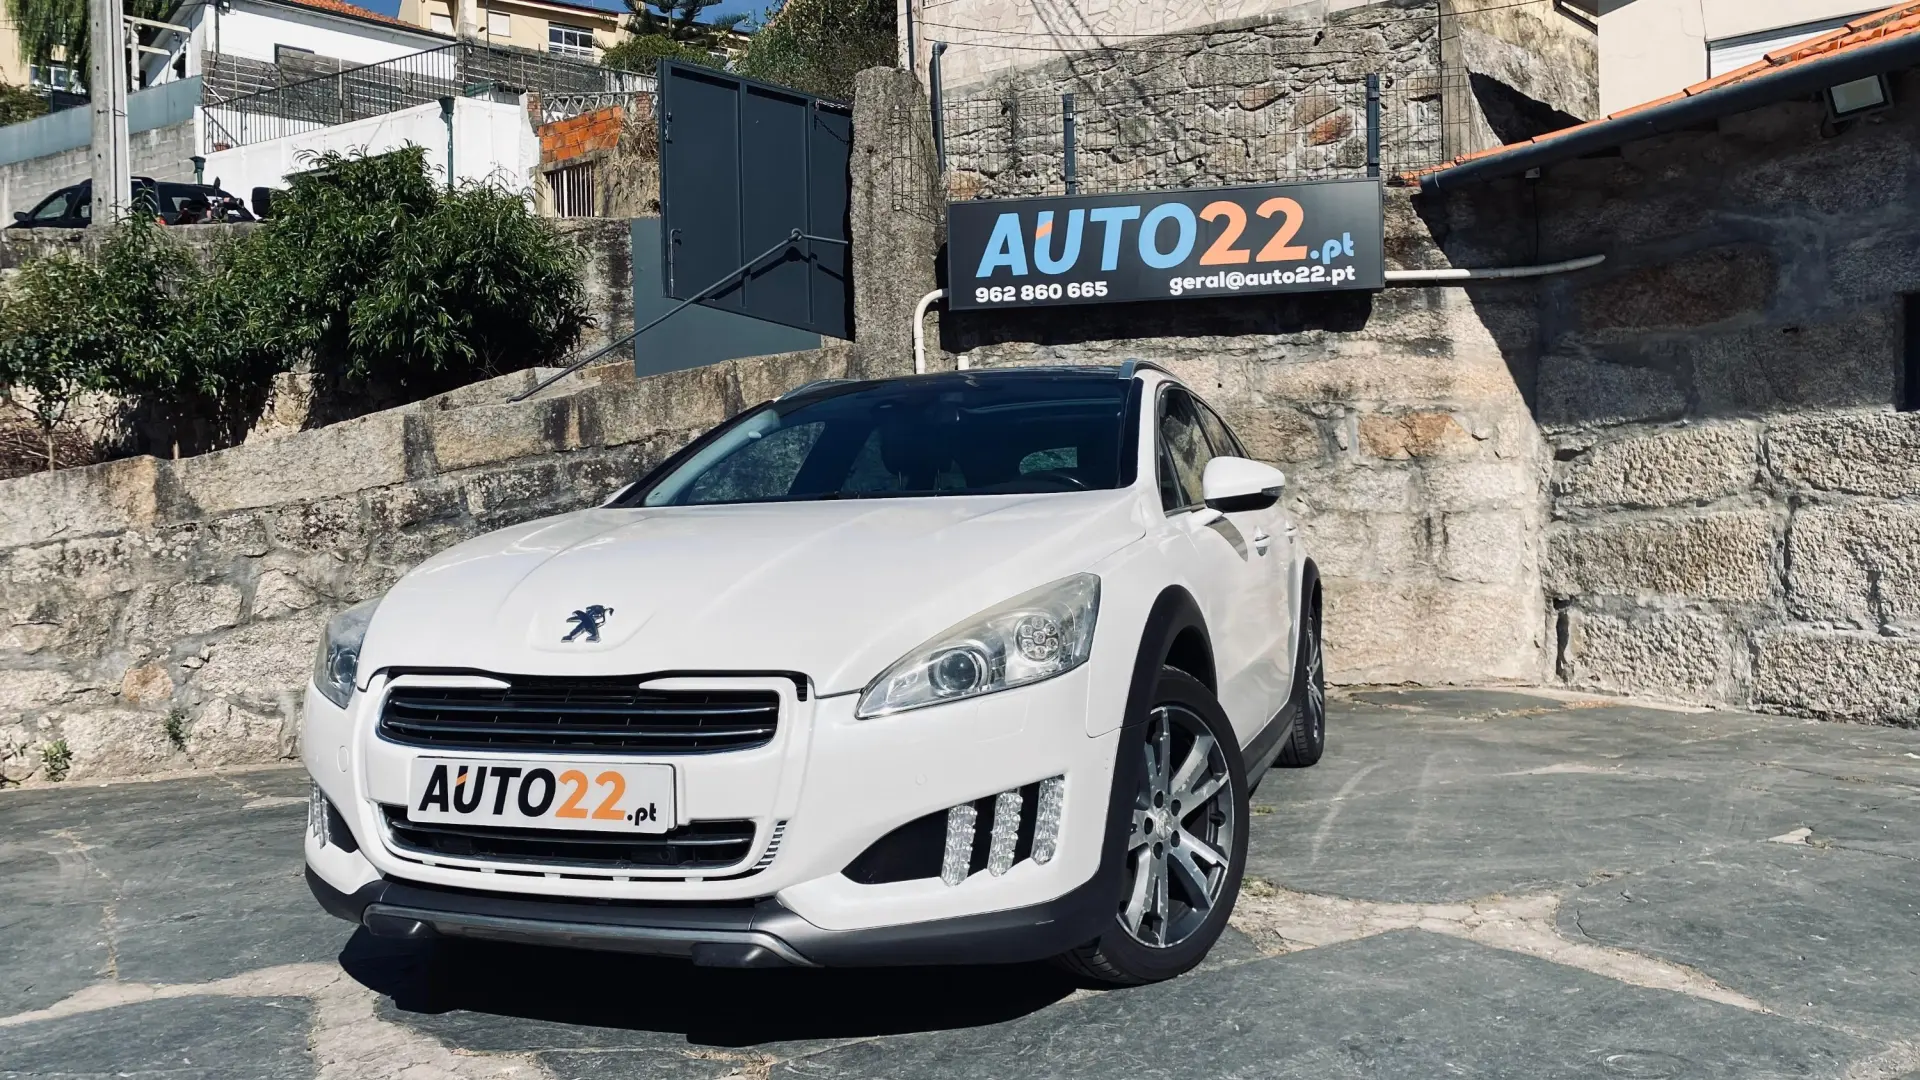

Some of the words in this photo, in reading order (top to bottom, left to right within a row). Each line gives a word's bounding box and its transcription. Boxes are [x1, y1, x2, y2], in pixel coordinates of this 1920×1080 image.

[976, 197, 1355, 277] AUTO22.pt
[975, 285, 1016, 303] 962
[1020, 283, 1063, 300] 860
[1066, 281, 1108, 298] 665
[1169, 265, 1356, 295] geral@auto22.pt
[418, 765, 657, 826] AUTO22.pt
